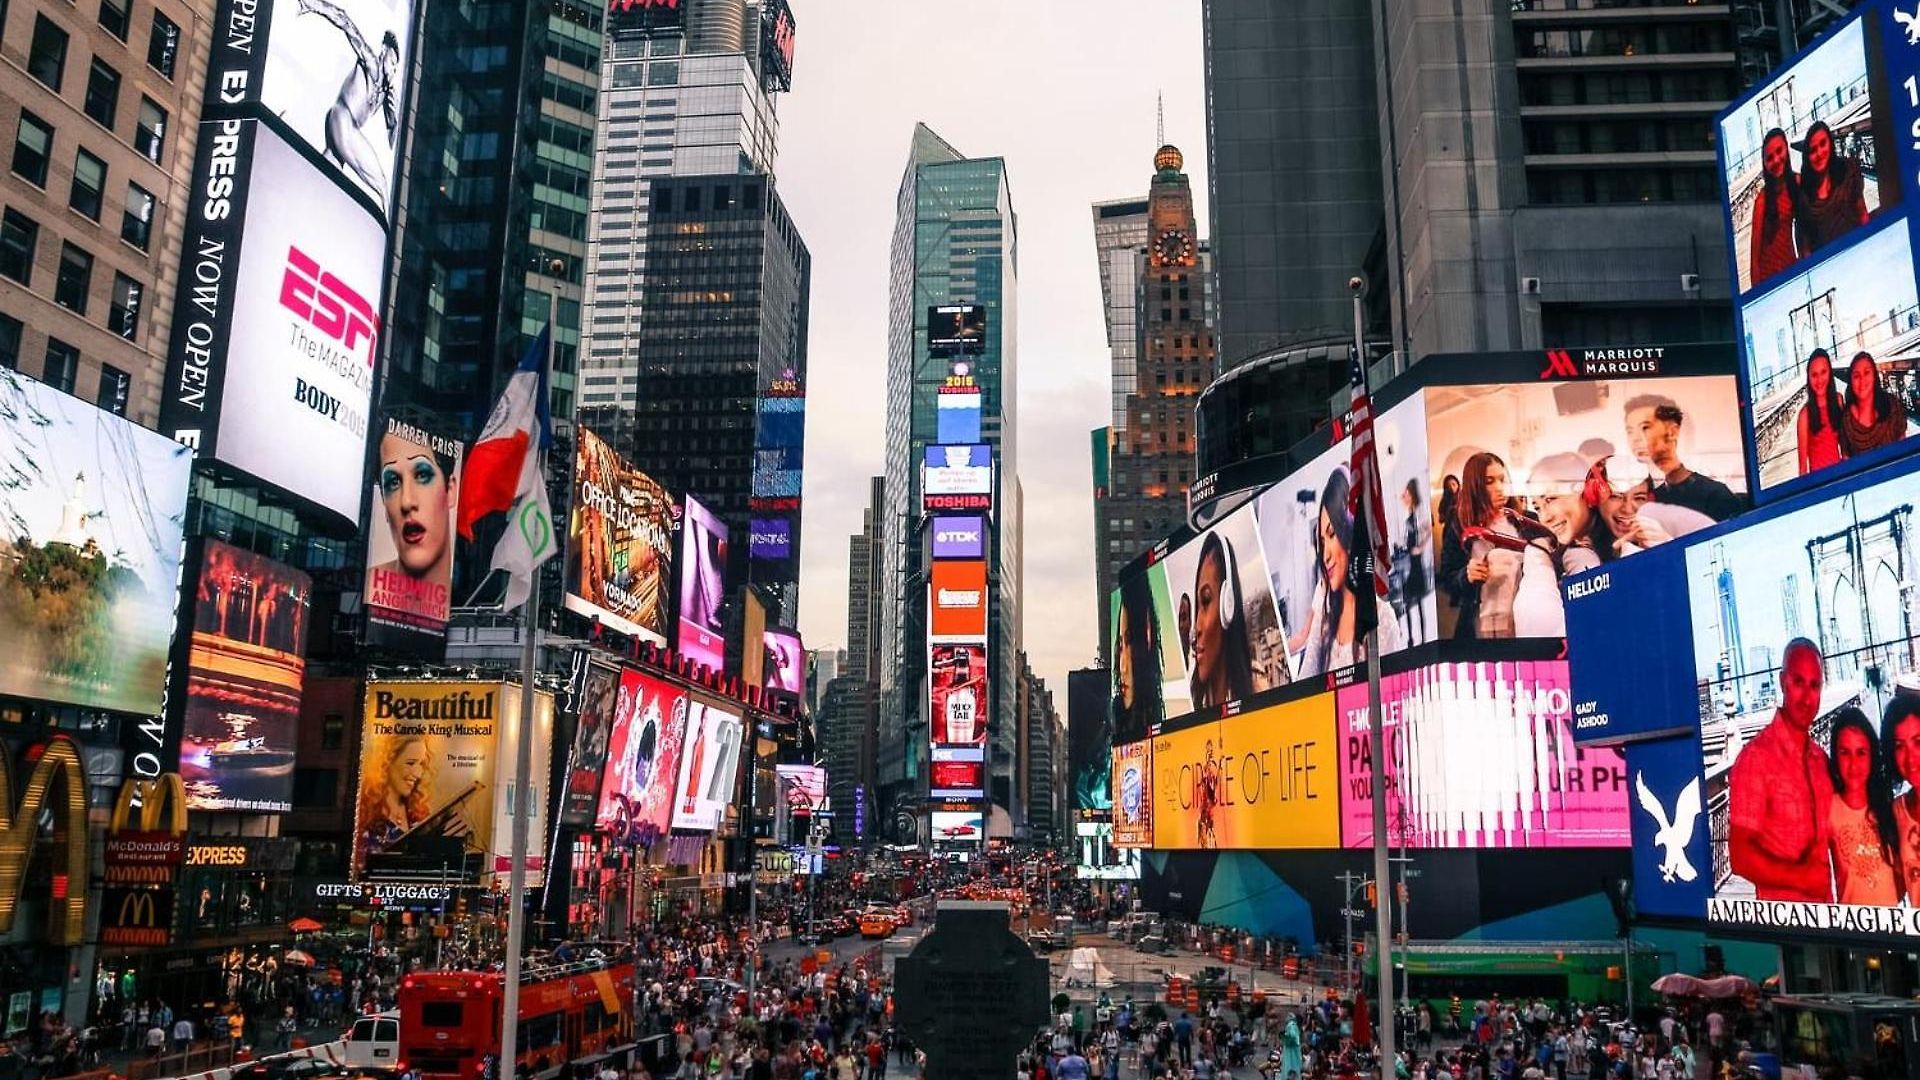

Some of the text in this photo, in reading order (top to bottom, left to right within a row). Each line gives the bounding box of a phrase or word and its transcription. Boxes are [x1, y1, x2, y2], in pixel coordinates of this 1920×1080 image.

[191, 235, 225, 318] NOW
[1584, 348, 1665, 361] MARRIOTT
[178, 322, 214, 412] OPEN
[1586, 361, 1656, 374] MARQUIS
[294, 377, 341, 422] BODY
[388, 417, 460, 459] DARREN CRISS
[582, 480, 617, 523] OFFICE
[925, 495, 990, 508] TOSHIBA
[947, 531, 979, 542] TDK
[1567, 572, 1611, 601] HELLO!!
[374, 691, 495, 720] Beautiful
[1575, 701, 1598, 716] GADY
[373, 723, 493, 738] The Carole King Musical
[1576, 713, 1609, 730] ASHDOD
[1241, 751, 1270, 805] OF
[1278, 741, 1318, 802] LIFE
[107, 840, 181, 852] McDonald's
[316, 883, 363, 897] GIFTS
[1709, 899, 1819, 927] AMERICAN
[1828, 905, 1906, 934] EAGLE
